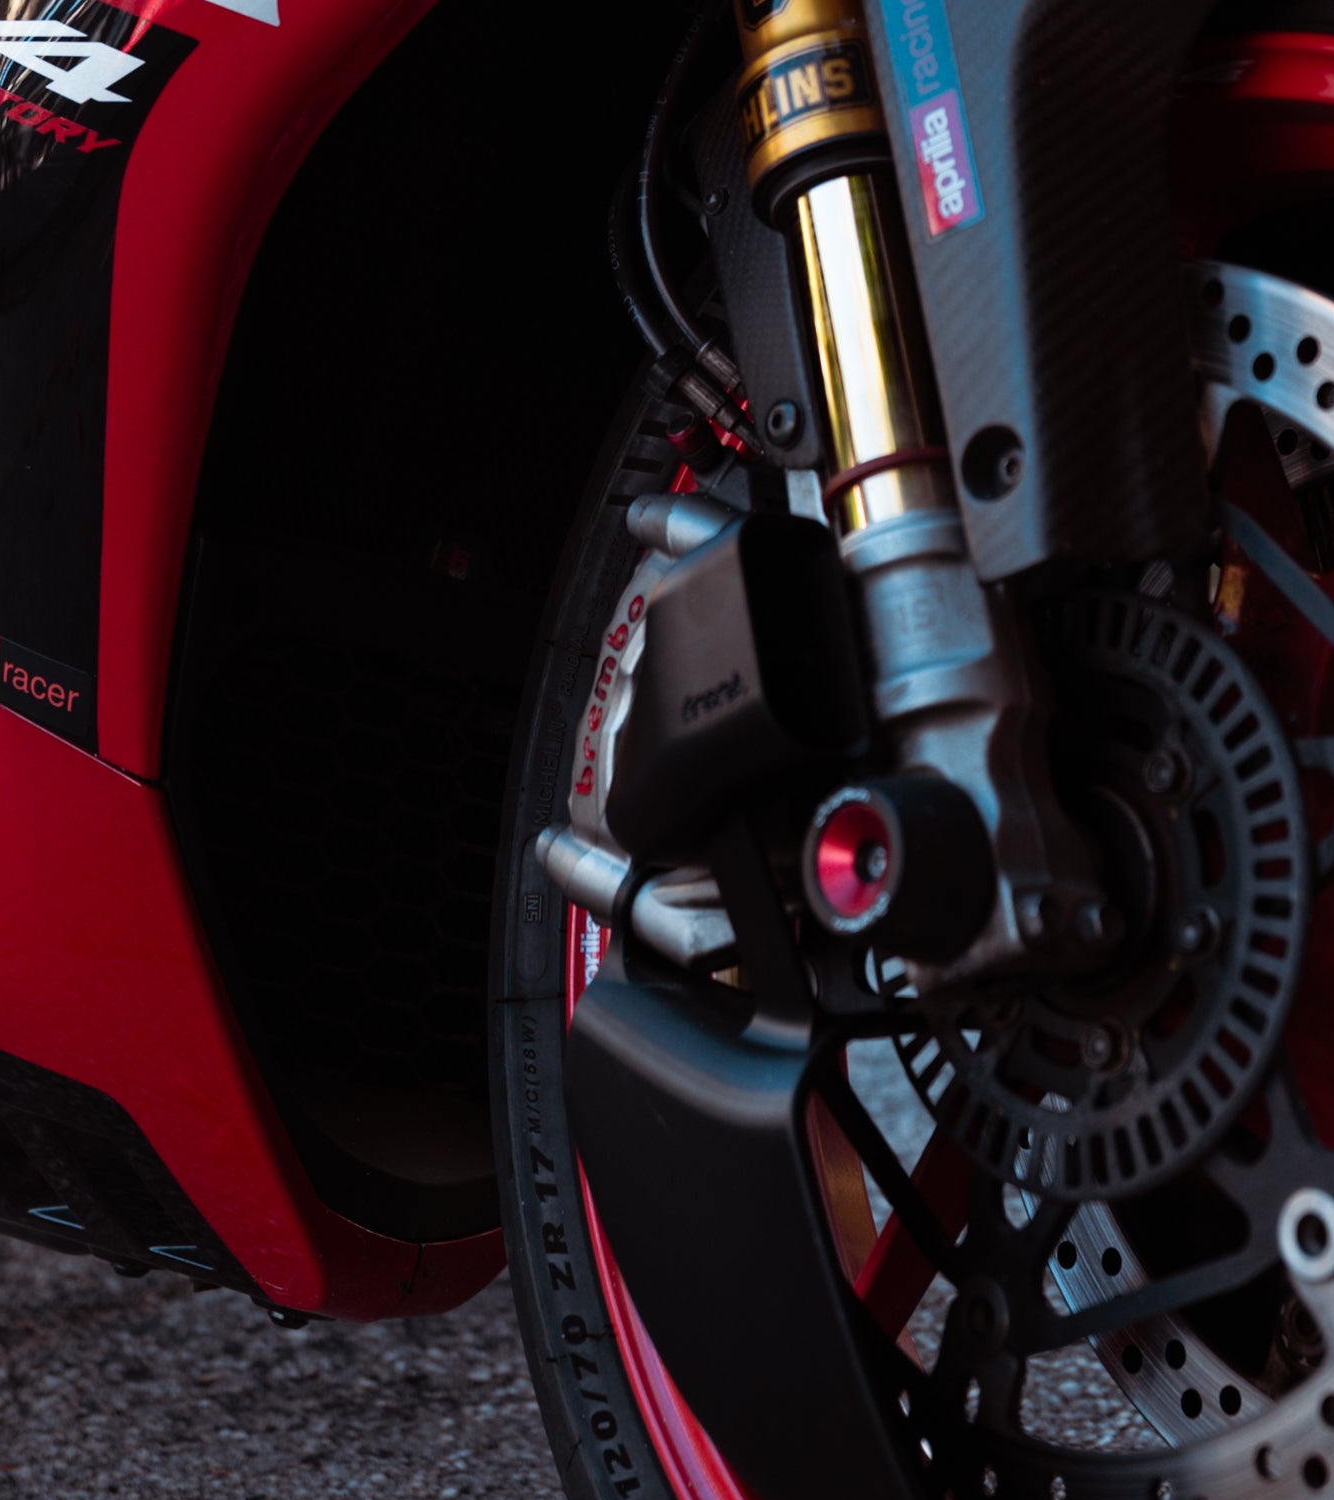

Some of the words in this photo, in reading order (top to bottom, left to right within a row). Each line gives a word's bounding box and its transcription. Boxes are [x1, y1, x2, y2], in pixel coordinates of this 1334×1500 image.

[922, 106, 966, 220] aprilia
[2, 660, 80, 712] racer
[574, 595, 645, 796] brembo
[533, 719, 567, 826] MICHELIN
[531, 1145, 559, 1201] 17
[540, 1221, 577, 1292] ZR
